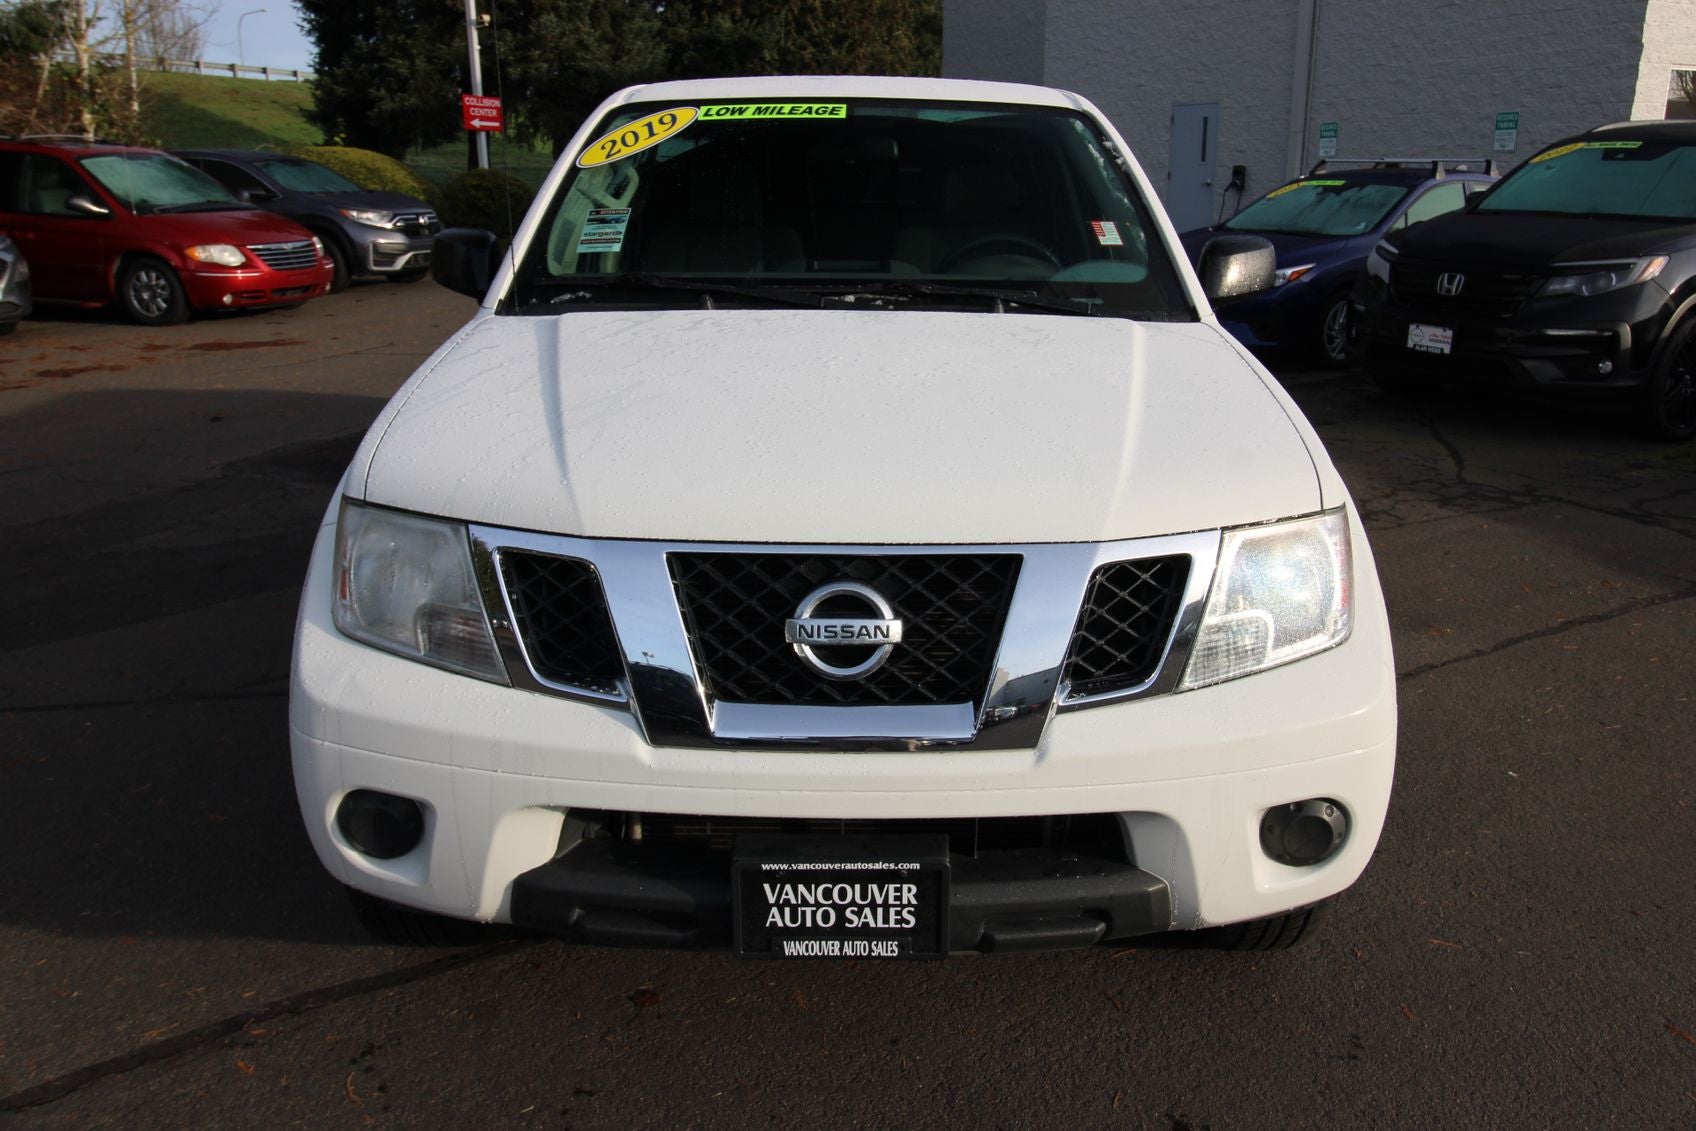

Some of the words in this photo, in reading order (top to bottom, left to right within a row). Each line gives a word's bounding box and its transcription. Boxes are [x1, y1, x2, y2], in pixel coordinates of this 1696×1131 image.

[464, 97, 501, 107] COLLISION
[470, 107, 497, 117] CENTER
[703, 107, 748, 118] LOW
[752, 106, 844, 117] MILEAGE
[601, 113, 678, 160] 2019
[798, 624, 890, 639] NISSAN
[761, 861, 920, 871] www.vancouverautosales.com
[763, 883, 918, 905] VANCOUVER
[766, 906, 836, 928] AUTO
[845, 906, 916, 928] SALES
[783, 940, 840, 956] VANCOUVER
[842, 940, 869, 956] AUTO
[871, 940, 898, 957] SALES
